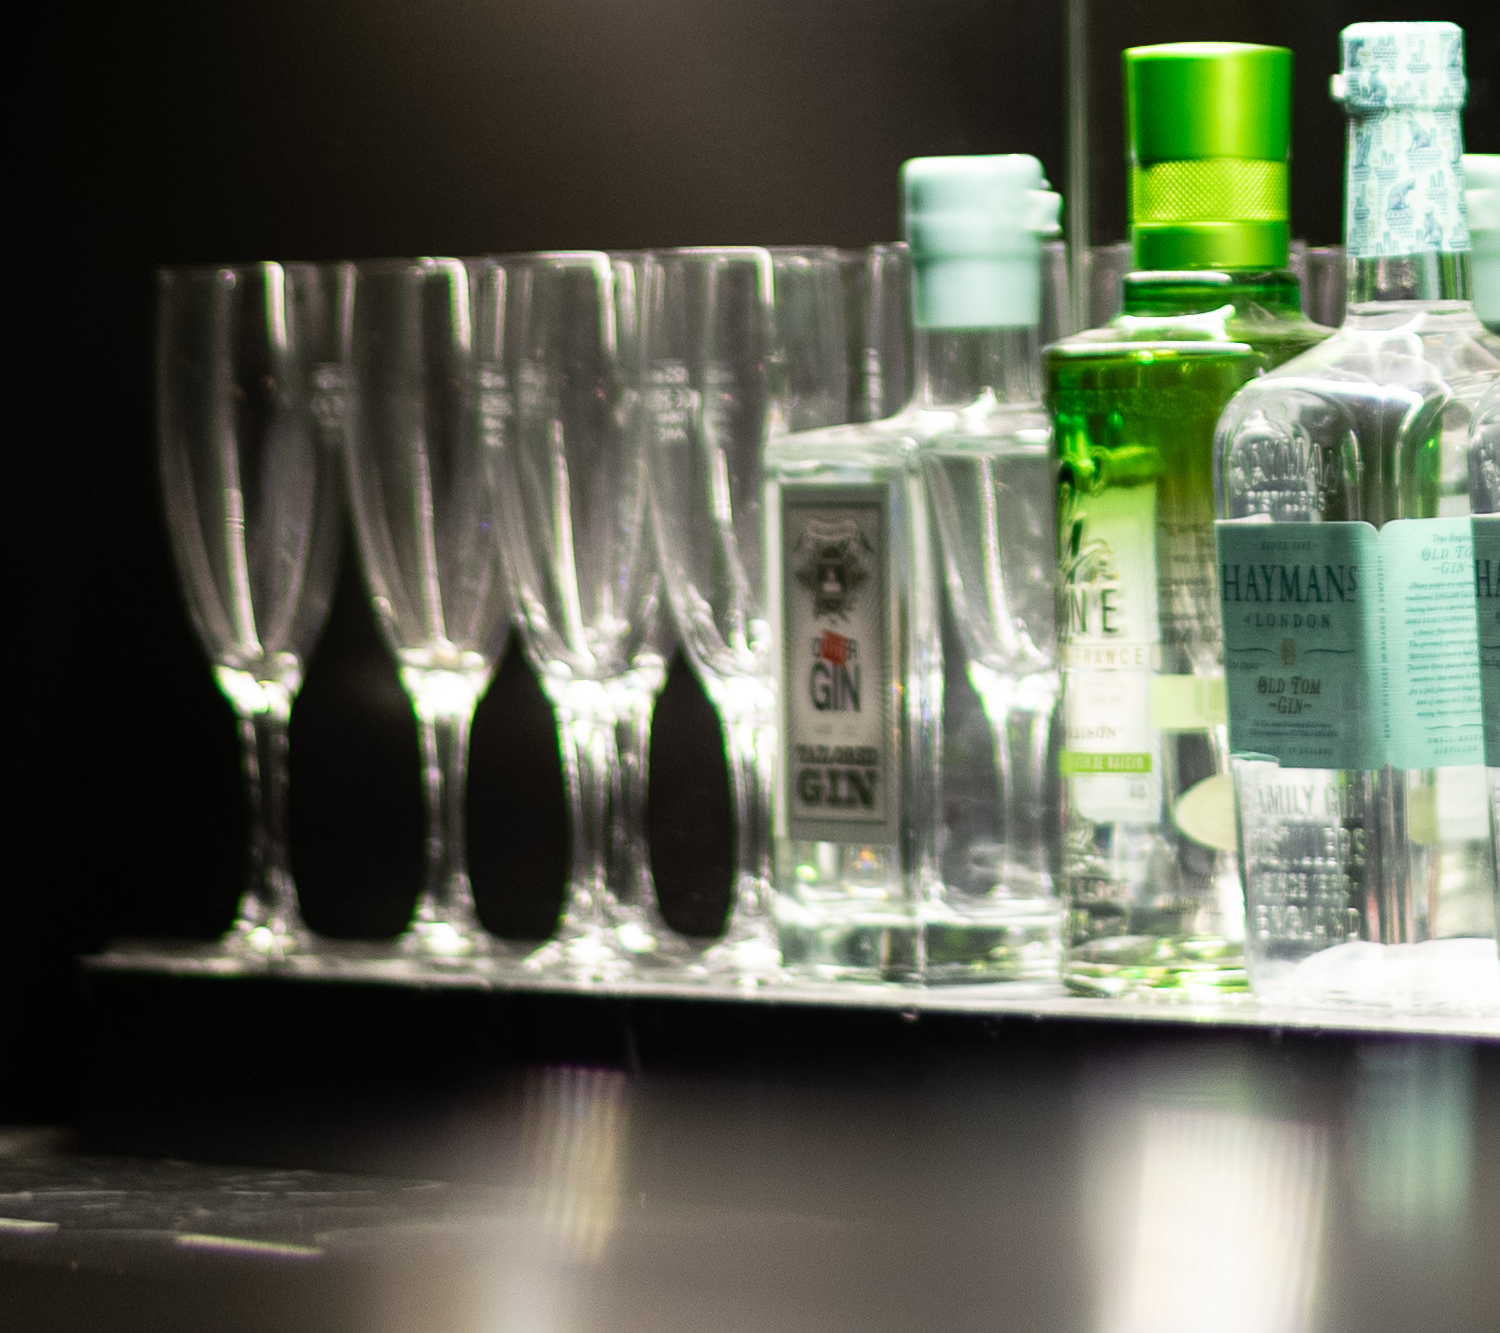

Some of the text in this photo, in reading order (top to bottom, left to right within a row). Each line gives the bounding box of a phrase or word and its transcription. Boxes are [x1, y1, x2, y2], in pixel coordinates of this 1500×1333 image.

[1222, 563, 1359, 604] HAYMANS
[1256, 613, 1332, 628] LONDON
[1070, 646, 1146, 667] FRANCE
[809, 661, 861, 713] GIN
[797, 766, 880, 811] GIN
